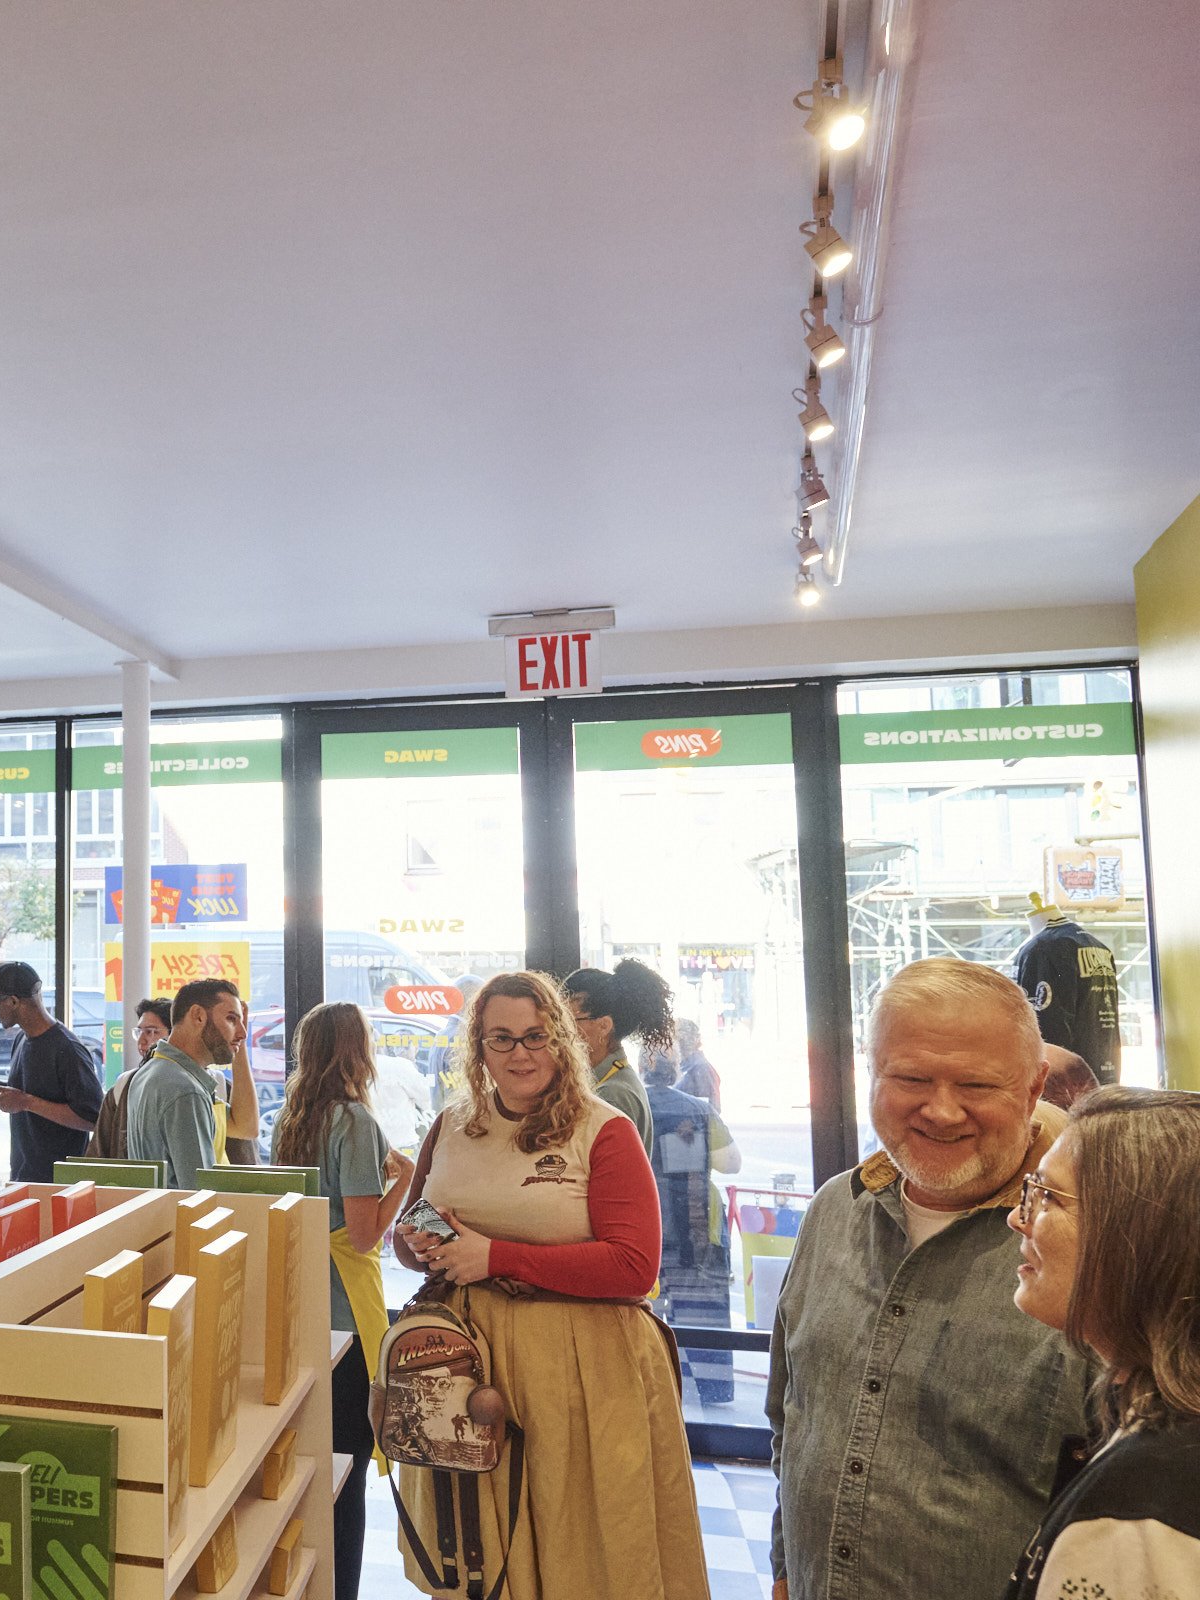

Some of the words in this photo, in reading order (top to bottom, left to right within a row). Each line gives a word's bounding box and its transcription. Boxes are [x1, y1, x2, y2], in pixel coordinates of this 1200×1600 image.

[517, 633, 592, 692] EXIT
[397, 1344, 448, 1367] INDIANA
[30, 1464, 61, 1485] ELI
[30, 1485, 94, 1510] PERS
